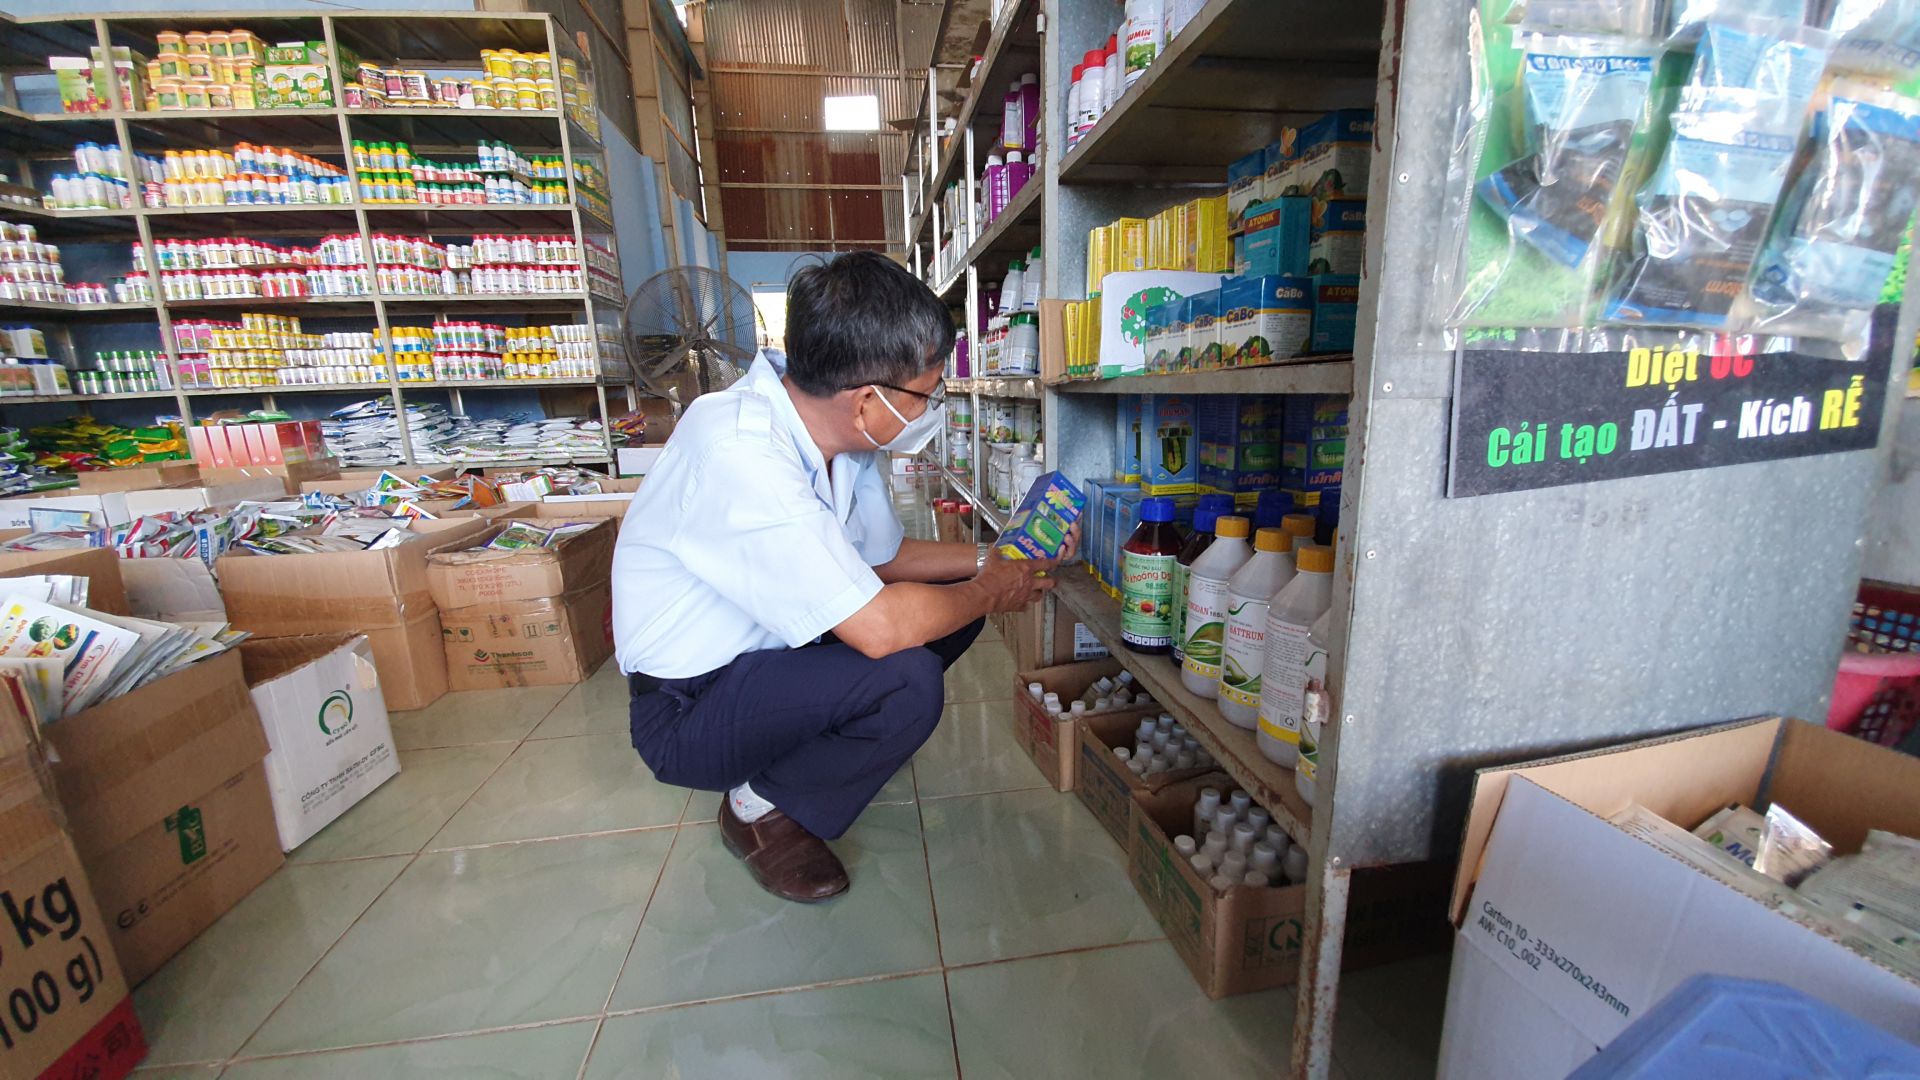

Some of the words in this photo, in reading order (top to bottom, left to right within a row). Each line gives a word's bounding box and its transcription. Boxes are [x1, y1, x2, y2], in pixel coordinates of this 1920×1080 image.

[1225, 307, 1256, 324] CaBo
[1275, 287, 1303, 299] CaBo
[1626, 343, 1700, 391] Diệt
[1486, 420, 1546, 467] Cải
[1560, 422, 1618, 465] tạo
[1630, 391, 1704, 451] ĐẤT
[1712, 419, 1728, 429] -
[1738, 396, 1811, 439] Kích
[1819, 376, 1865, 431] RỄ
[0, 876, 82, 949] kg
[1477, 915, 1496, 937] AW:
[1496, 930, 1542, 971] C10_002
[66, 935, 104, 1004] g)
[1482, 900, 1513, 931] Carton
[1515, 923, 1528, 941] 10
[1533, 938, 1631, 1017] 333x270x243mm
